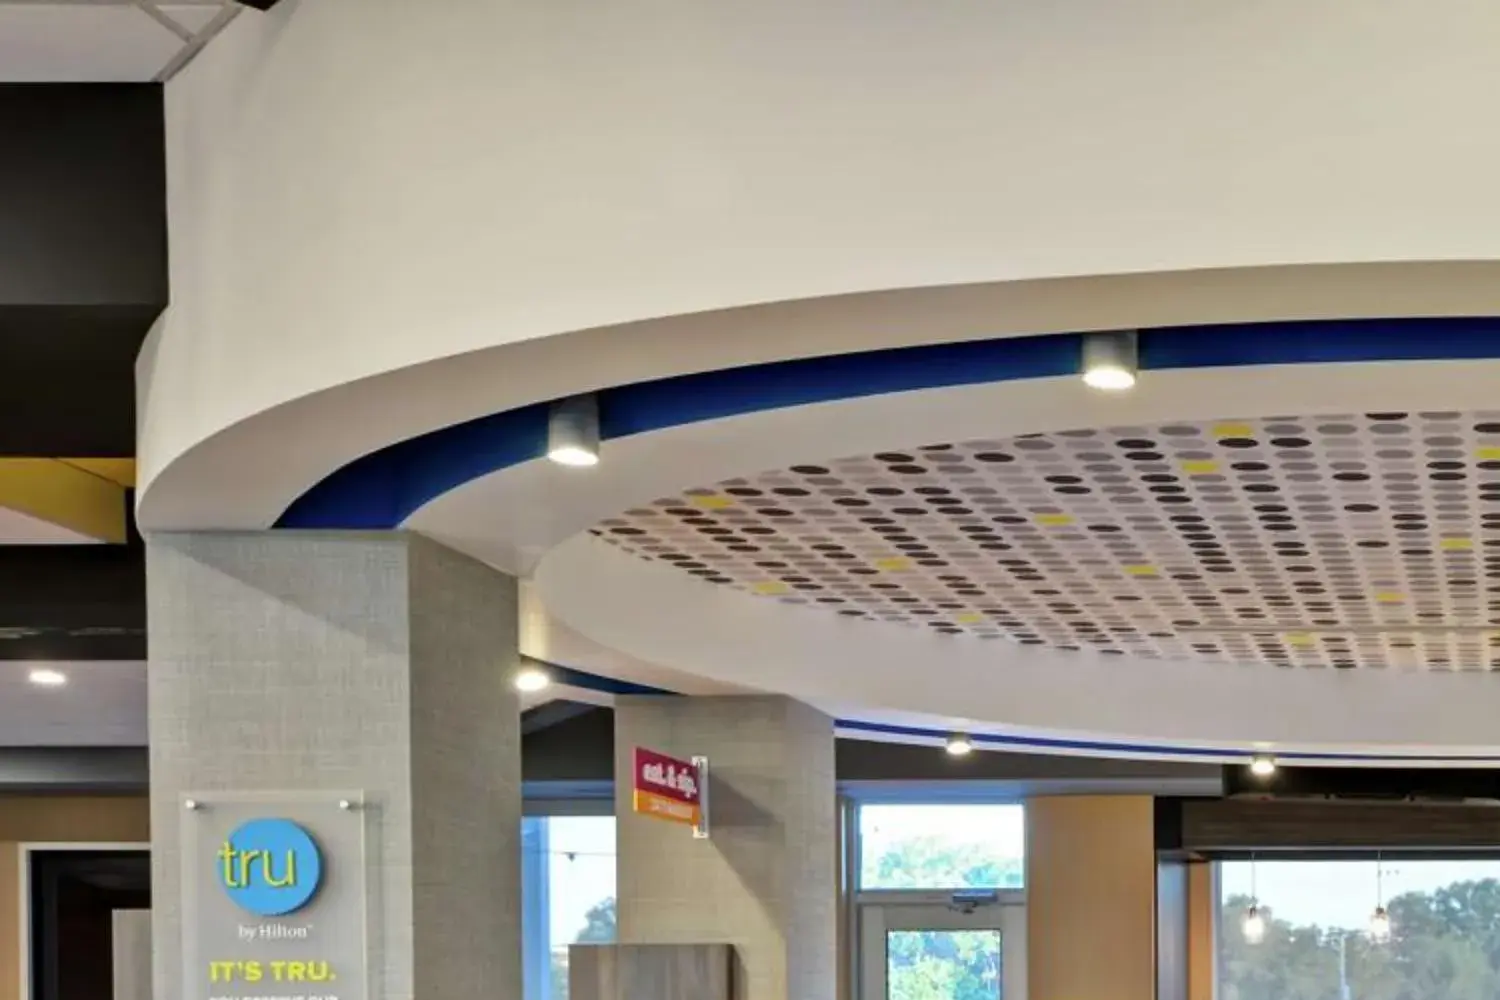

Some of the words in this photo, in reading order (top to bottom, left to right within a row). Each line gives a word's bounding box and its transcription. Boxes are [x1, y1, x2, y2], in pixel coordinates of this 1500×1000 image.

[217, 840, 297, 889] tru
[238, 923, 257, 943] by
[209, 960, 263, 983] IT'S
[270, 960, 337, 983] TRU.
